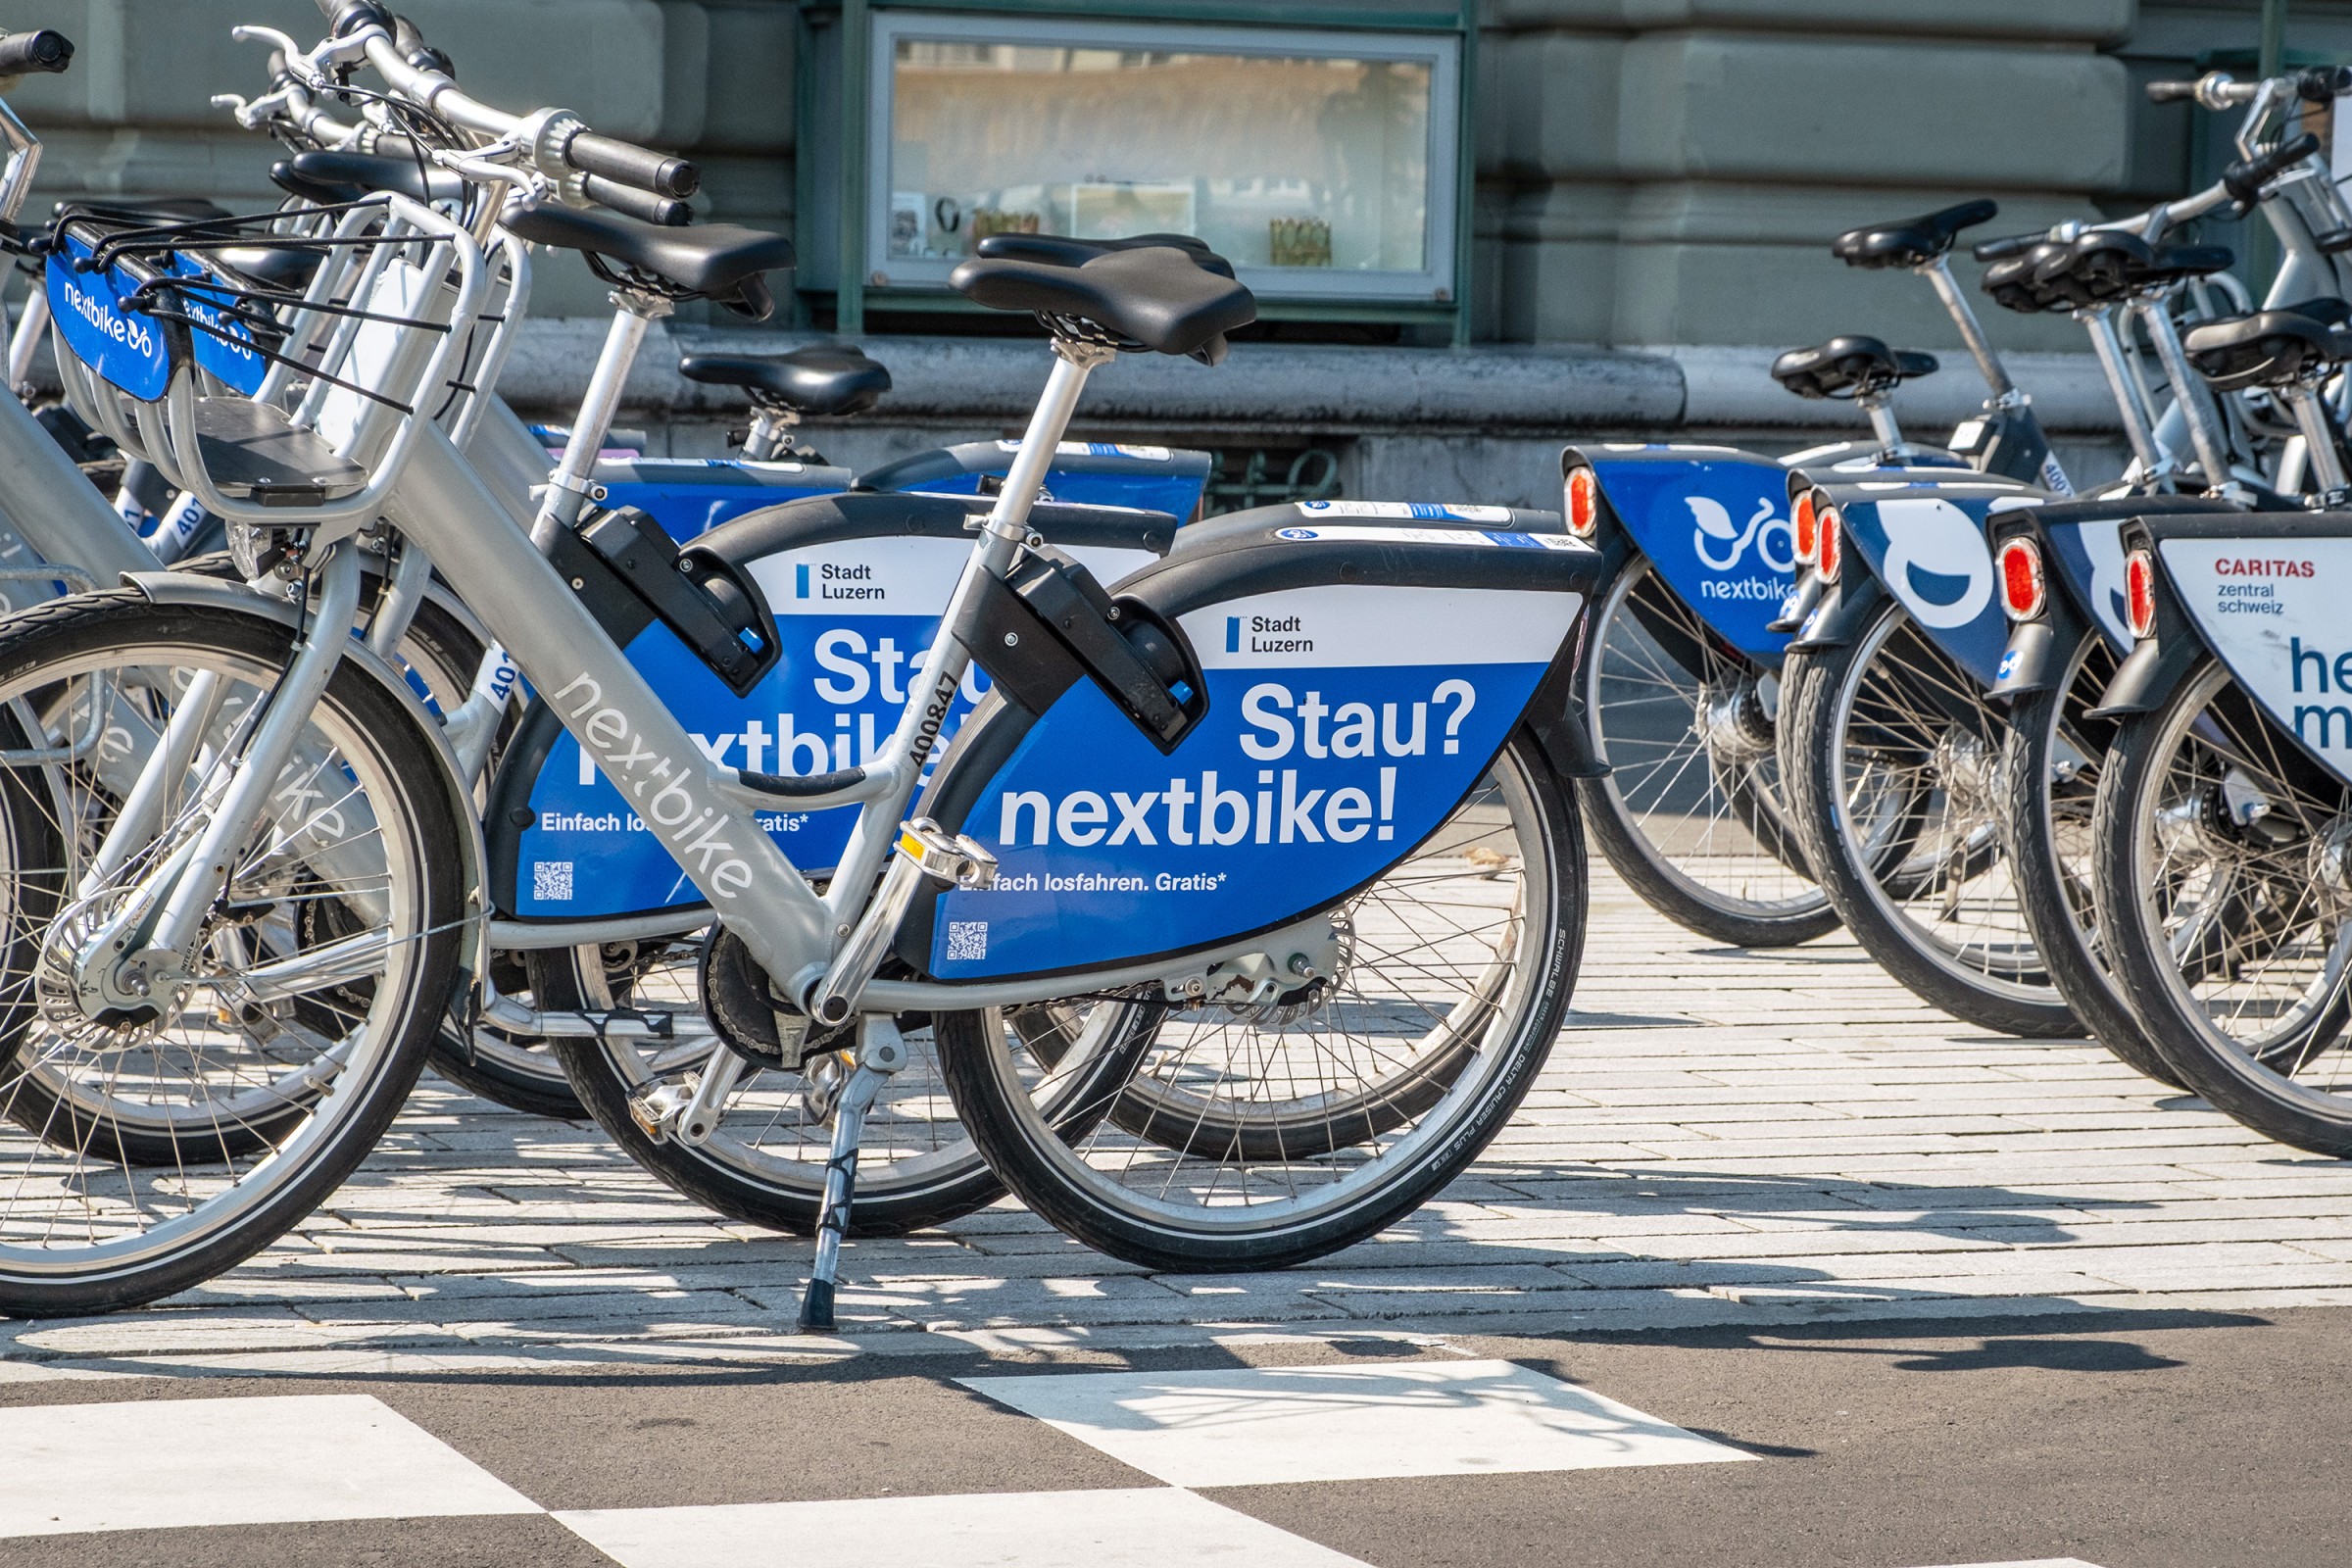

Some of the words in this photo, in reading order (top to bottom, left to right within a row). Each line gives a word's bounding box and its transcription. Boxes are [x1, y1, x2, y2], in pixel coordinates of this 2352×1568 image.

[65, 281, 125, 342] nextbike
[821, 564, 871, 580] Stadt
[2215, 558, 2316, 578] CARITAS
[822, 583, 885, 600] Luzern
[2218, 583, 2275, 598] zentral
[2218, 599, 2284, 615] schweiz
[1251, 615, 1301, 633] Stadt
[1251, 636, 1314, 653] Luzern
[909, 670, 958, 767] 400847
[1239, 678, 1477, 761] Stau?
[554, 671, 754, 899] nextbike
[998, 765, 1397, 847] nextbike!
[542, 812, 620, 832] Einfach
[1045, 871, 1150, 892] losfahren.
[1545, 928, 1566, 999] SCHWALBE
[1505, 1054, 1526, 1086] DELTA
[1475, 1085, 1507, 1127] CRUISER
[1453, 1125, 1476, 1152] PLUS
